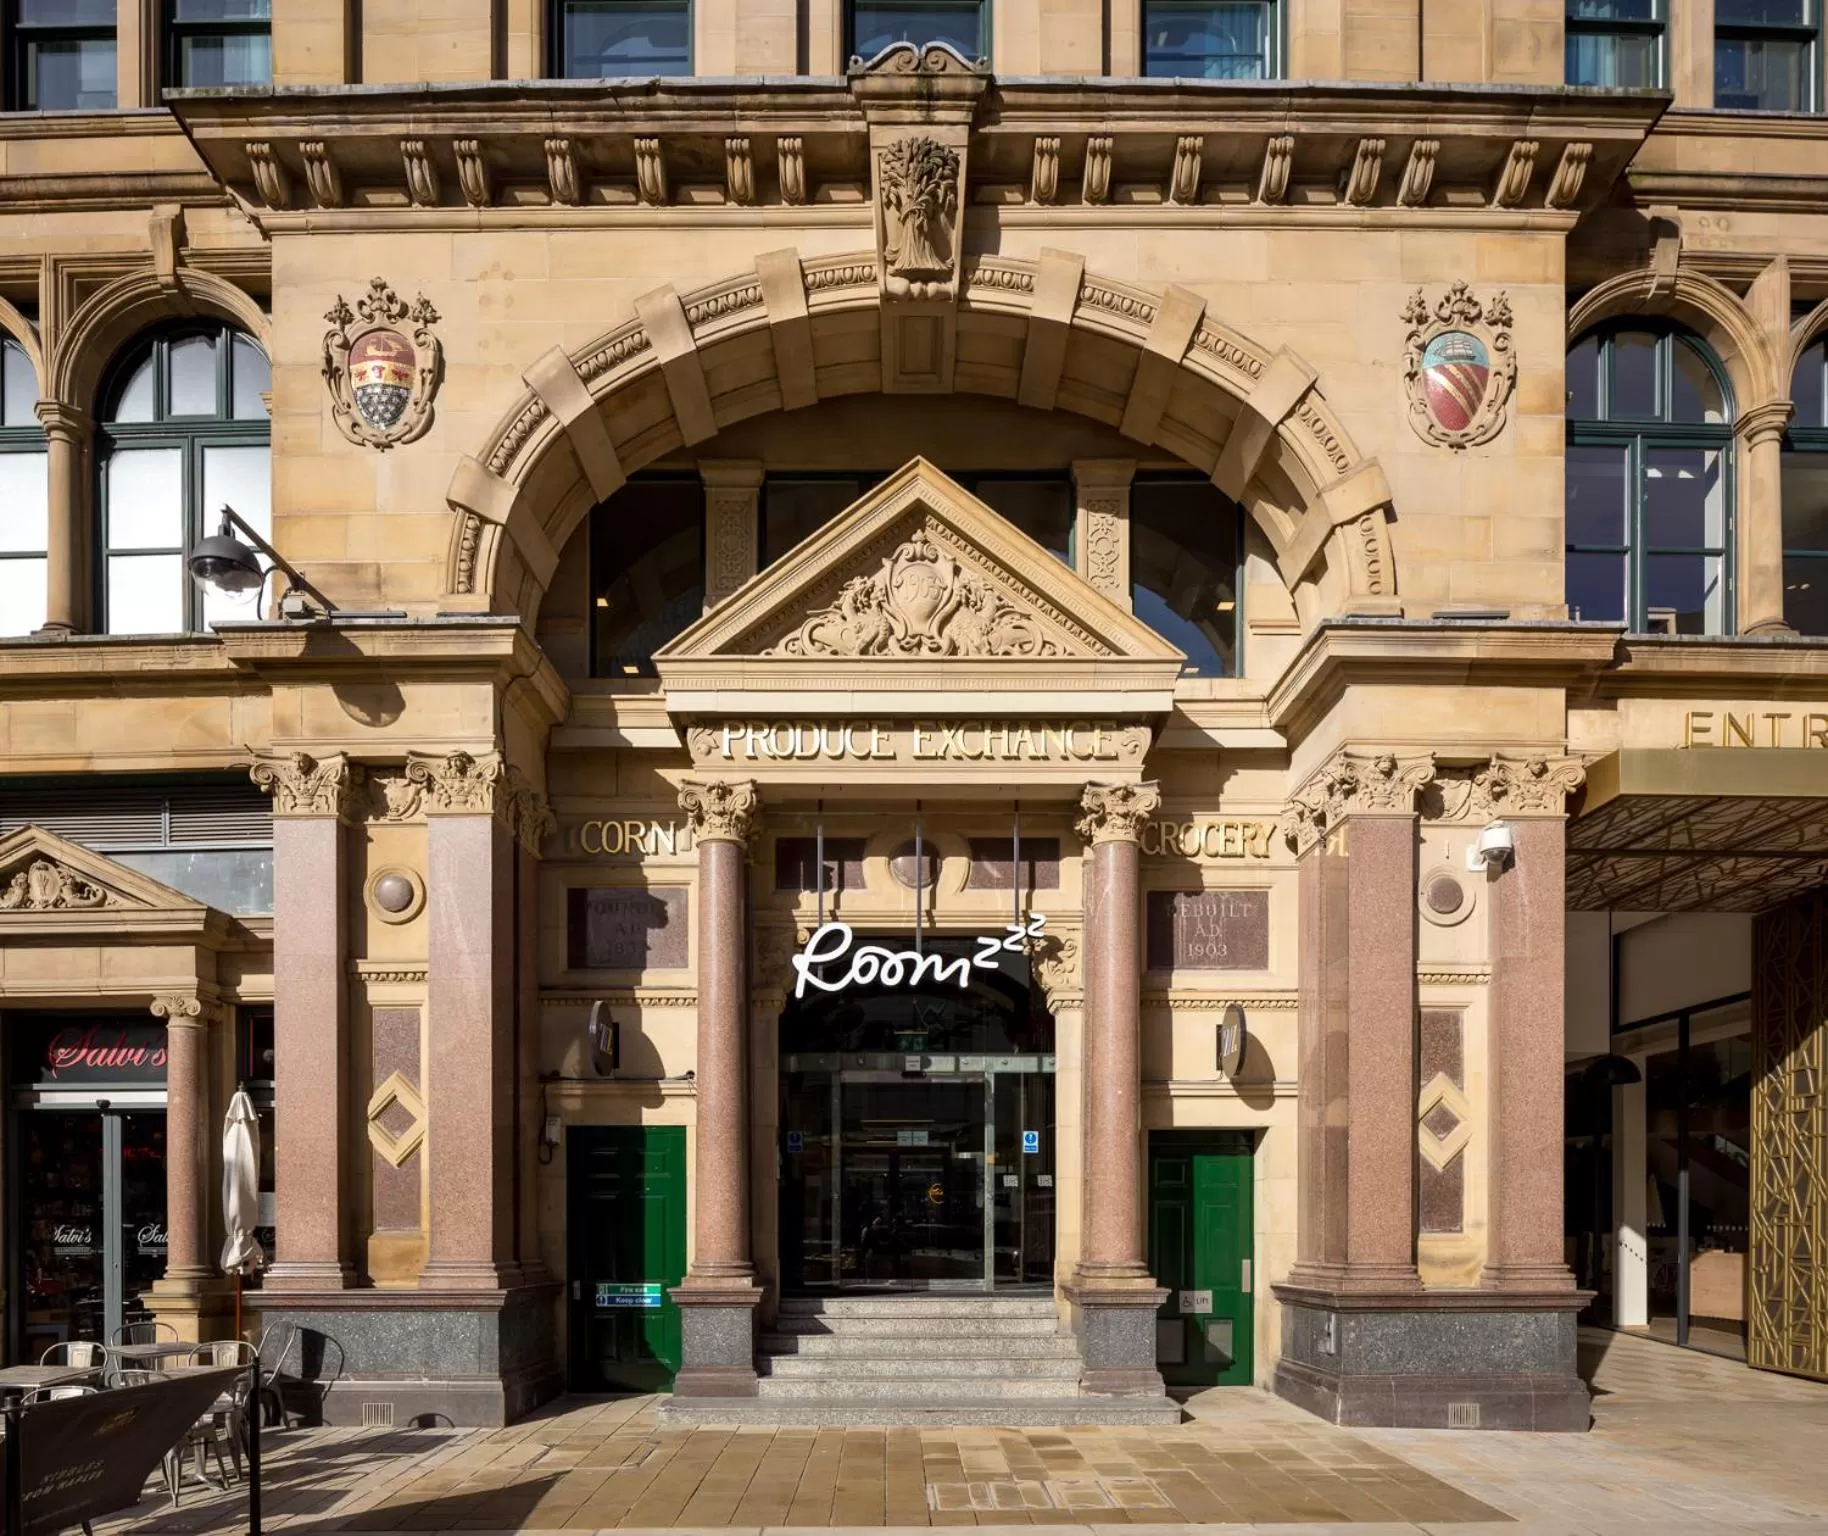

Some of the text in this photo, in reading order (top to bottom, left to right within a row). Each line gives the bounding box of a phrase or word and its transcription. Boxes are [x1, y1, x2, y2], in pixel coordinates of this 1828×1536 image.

[722, 719, 1119, 761] PRODUCE EXCHANGE
[580, 820, 677, 855] CORN
[1140, 821, 1277, 858] GROCERY
[1187, 943, 1227, 957] 1903
[616, 1296, 633, 1305] Keep
